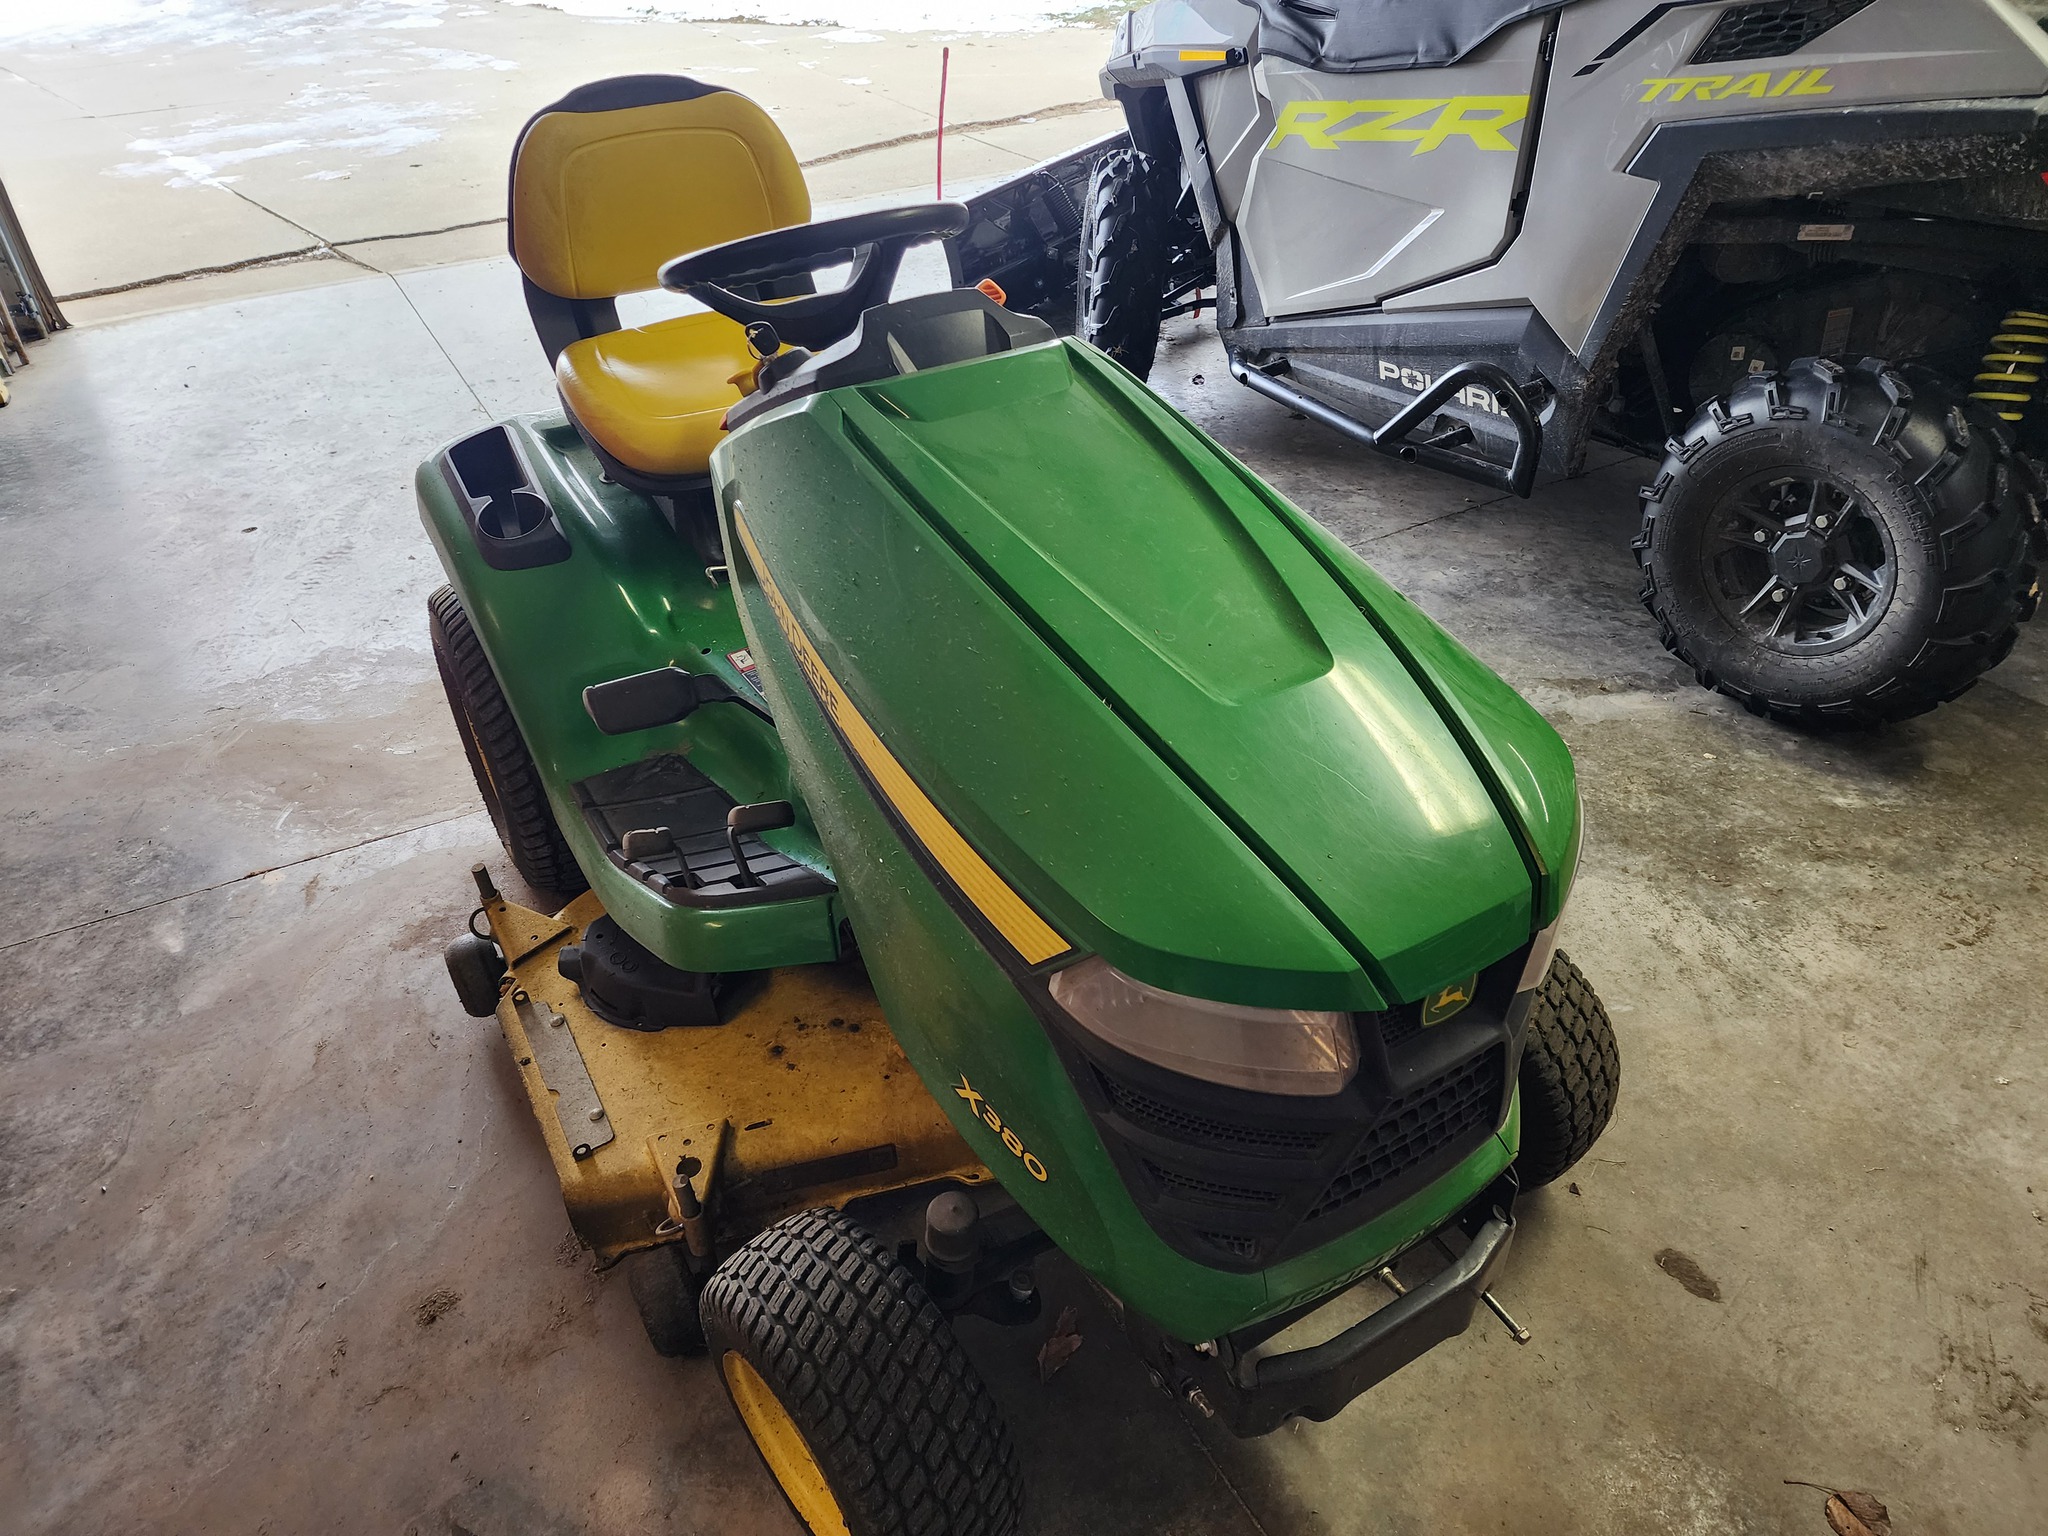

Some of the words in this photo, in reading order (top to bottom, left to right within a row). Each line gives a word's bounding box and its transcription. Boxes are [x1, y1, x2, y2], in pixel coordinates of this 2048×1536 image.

[1269, 94, 1531, 154] RZR
[1640, 68, 1833, 101] TRAIL
[791, 621, 840, 721] DEERE
[953, 1070, 1049, 1183] X380
